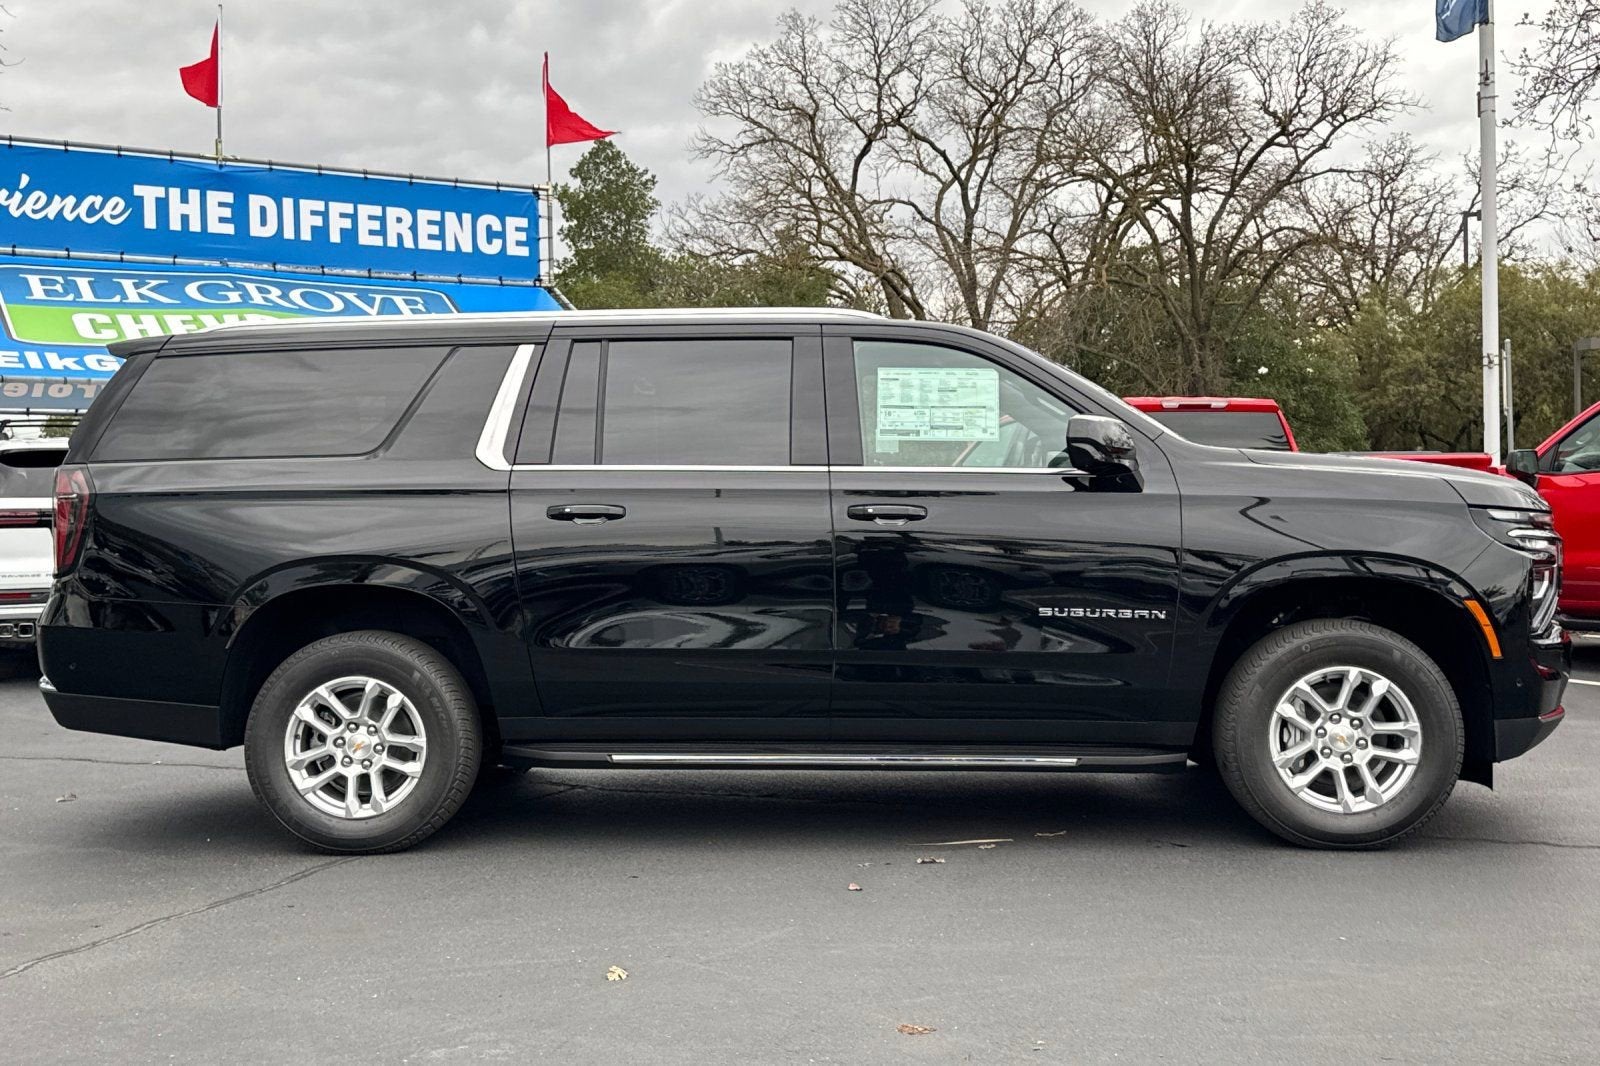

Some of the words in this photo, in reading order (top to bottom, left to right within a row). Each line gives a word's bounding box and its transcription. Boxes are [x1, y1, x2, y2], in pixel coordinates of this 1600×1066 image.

[133, 184, 235, 235] THE
[248, 193, 530, 257] DIFFERENCE
[19, 274, 181, 304] ELK
[184, 280, 434, 315] GROVE
[1038, 607, 1167, 619] SUBURBAN
